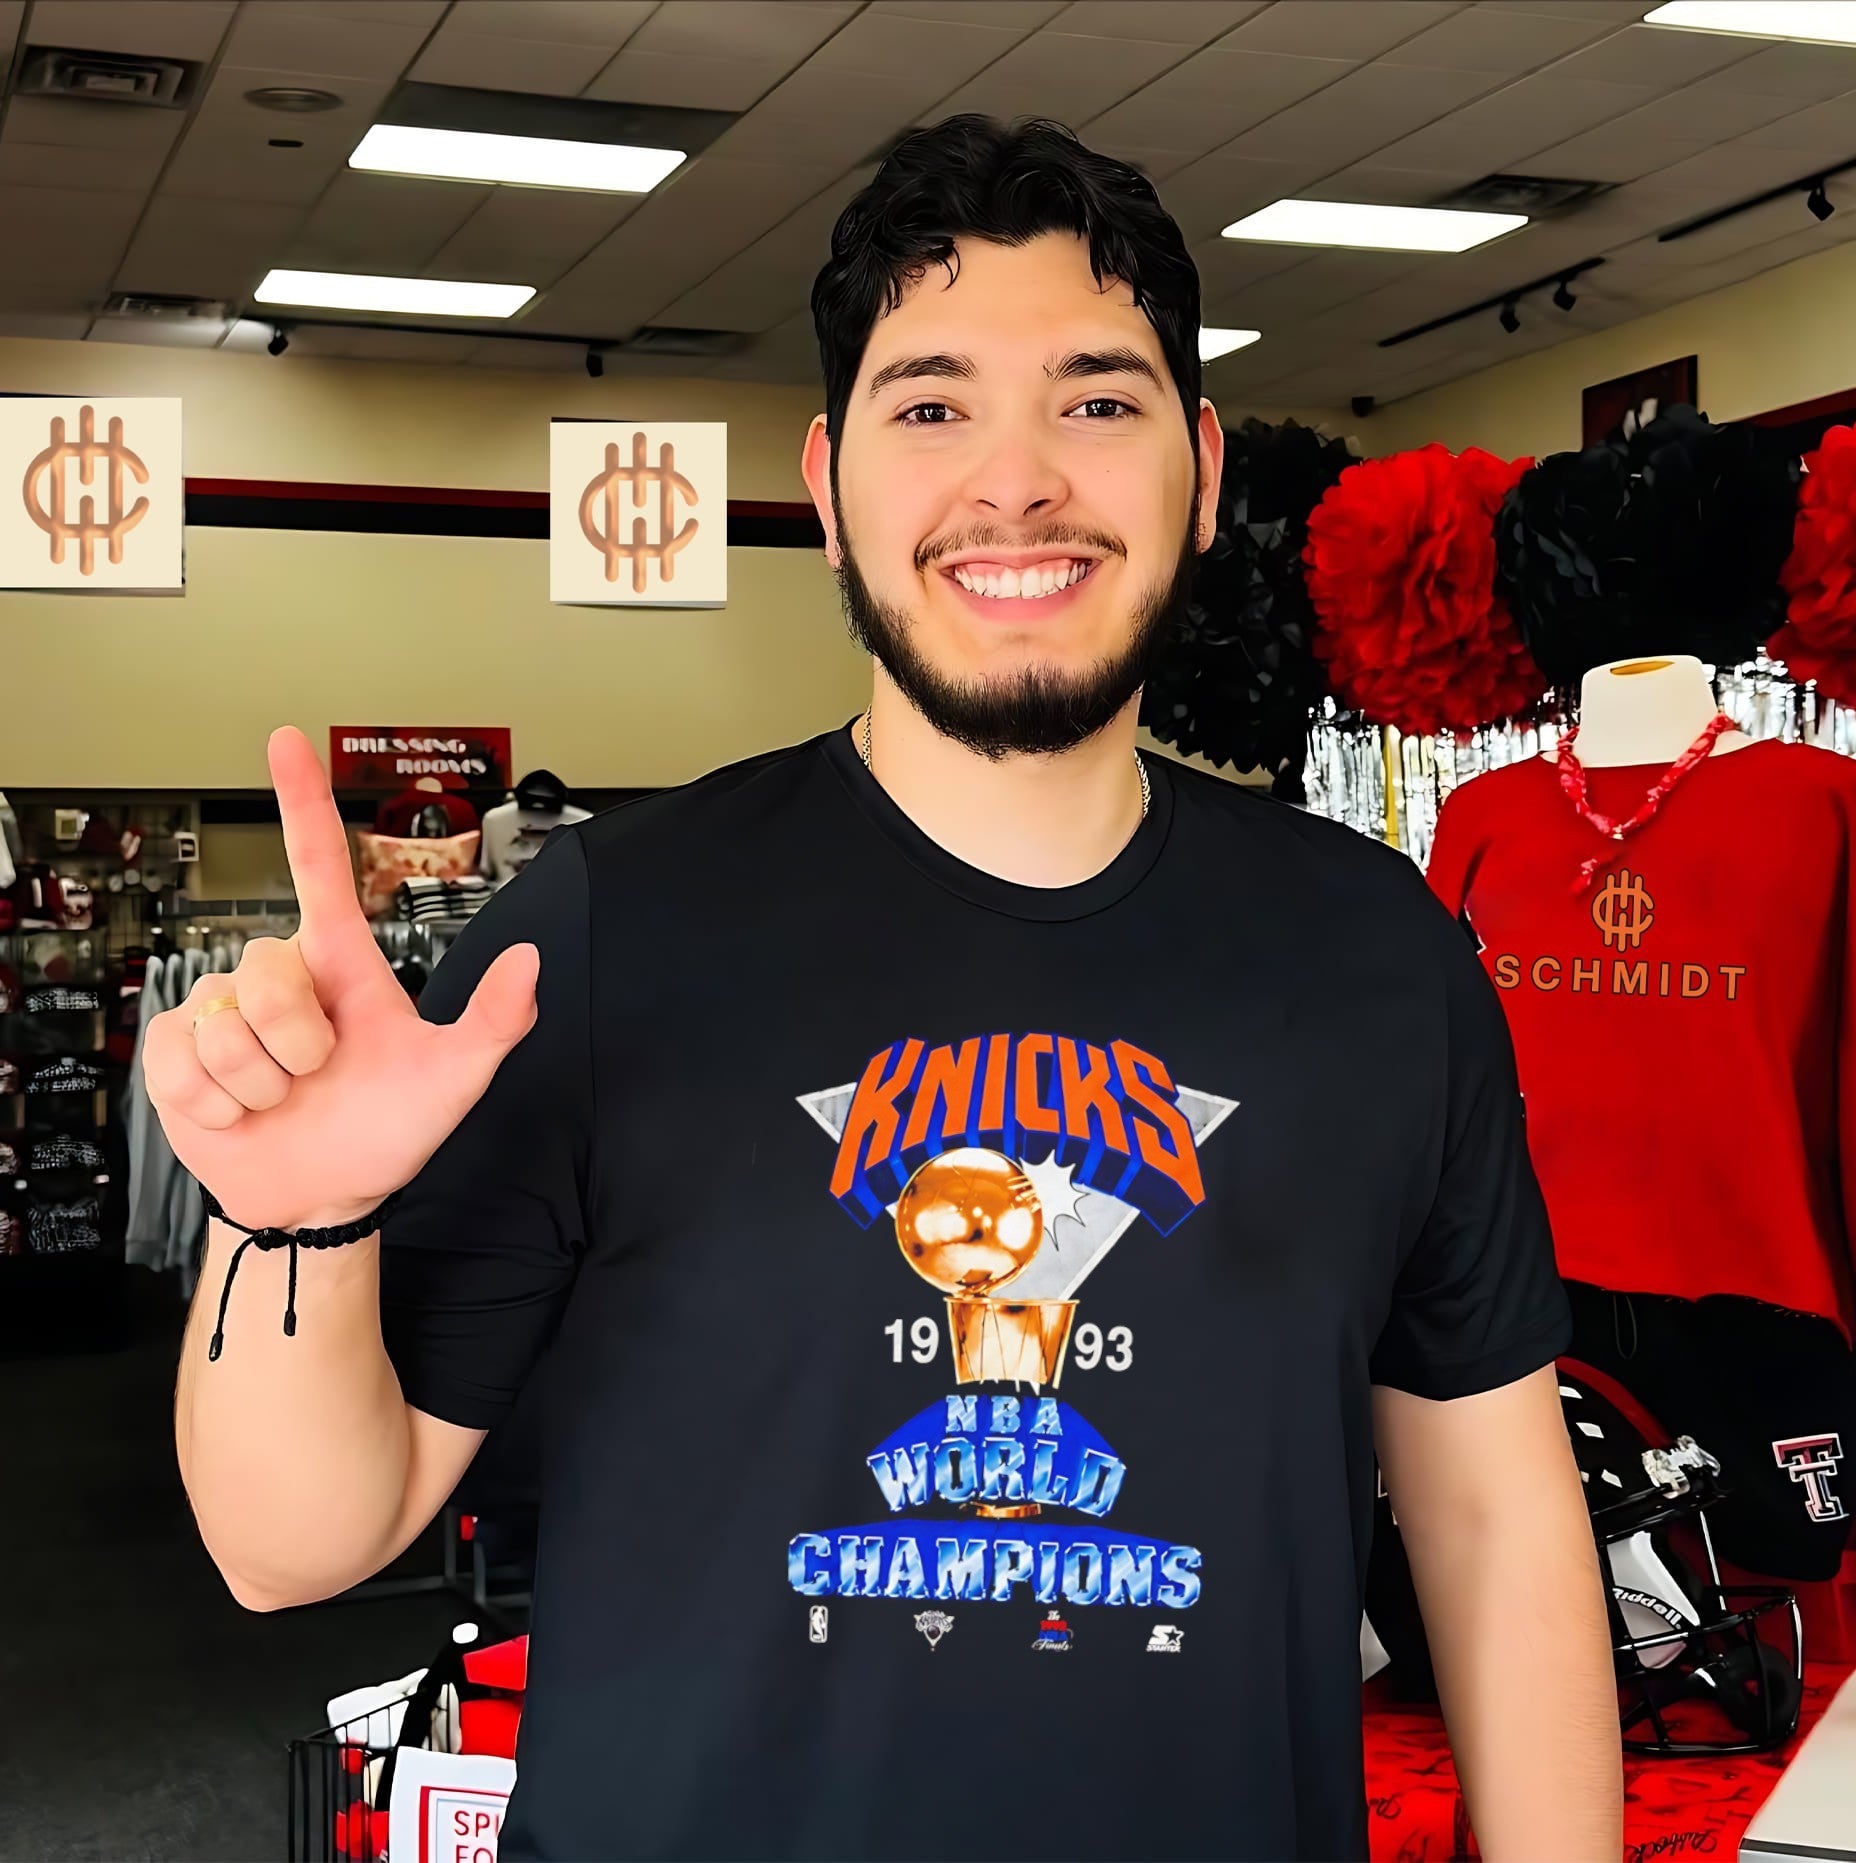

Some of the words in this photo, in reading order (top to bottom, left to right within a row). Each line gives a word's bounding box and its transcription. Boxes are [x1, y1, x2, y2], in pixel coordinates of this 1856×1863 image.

[342, 737, 467, 754] DRESSING
[396, 758, 487, 775] ROOMS
[1494, 954, 1747, 1000] SCHMIDT
[828, 1032, 1206, 1210] KNICKS
[884, 1316, 940, 1364] 19
[1074, 1322, 1134, 1372] 93
[945, 1394, 1063, 1437] NBA
[866, 1436, 1127, 1518] WORLD
[787, 1532, 1202, 1609] CHAMPIONS
